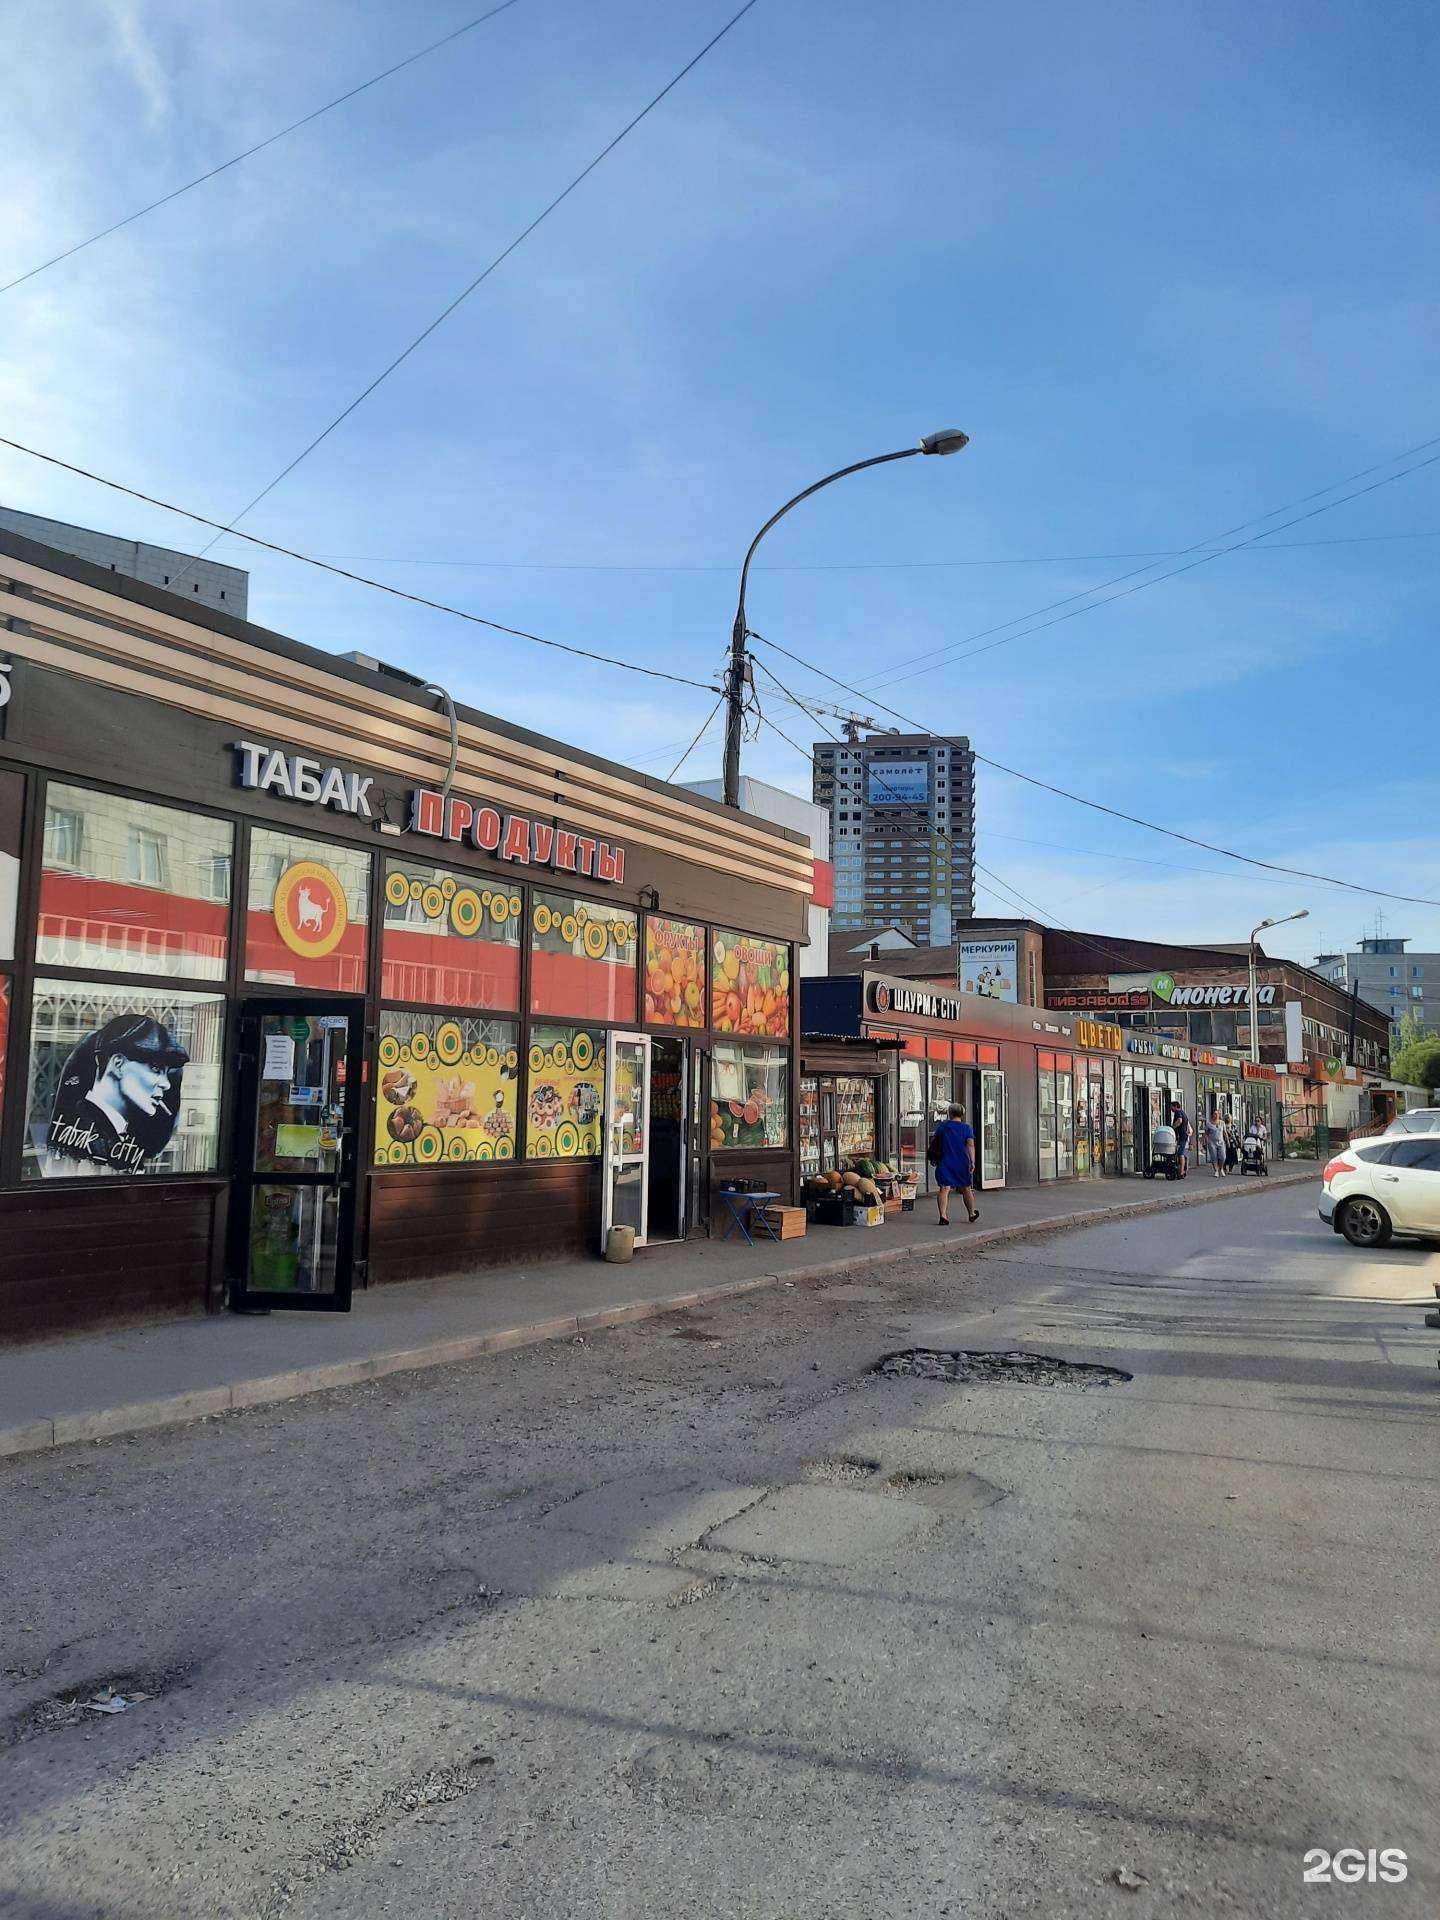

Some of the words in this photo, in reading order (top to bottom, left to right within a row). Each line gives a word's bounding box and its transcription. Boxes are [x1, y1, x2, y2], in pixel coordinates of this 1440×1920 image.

[236, 741, 373, 817] ТАБАК
[415, 788, 625, 884] ПРОДУКТЫ
[961, 941, 1016, 953] МЕРКУРИЙ
[894, 988, 938, 1018] ШАУРМА
[940, 996, 960, 1021] CITY
[1047, 993, 1129, 1007] ПИВЗАВОД
[1079, 1020, 1122, 1050] ЦВЕТЫ
